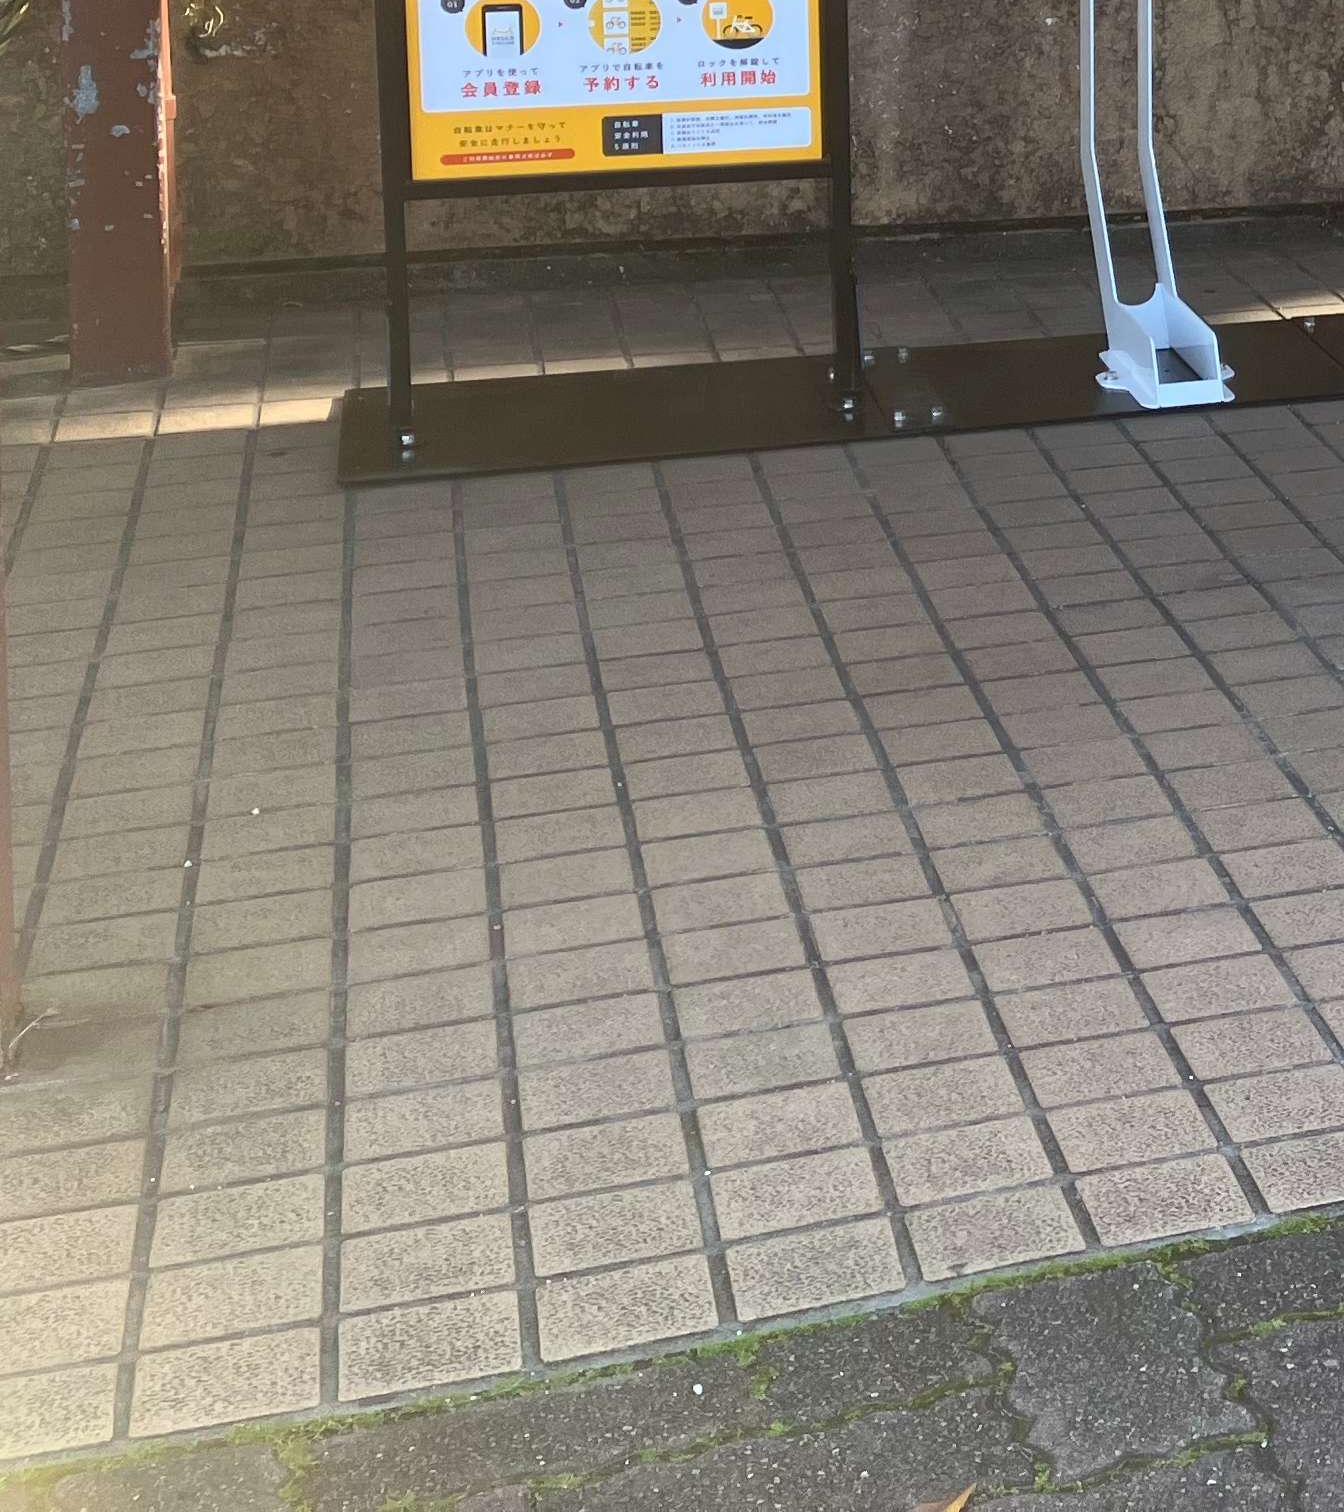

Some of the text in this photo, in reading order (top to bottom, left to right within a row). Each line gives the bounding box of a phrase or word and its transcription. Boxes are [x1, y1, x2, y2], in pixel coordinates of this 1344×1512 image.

[463, 67, 539, 78] アプリを使って
[579, 61, 664, 73] アプリで自転車を
[583, 74, 659, 93] 予約する
[700, 69, 777, 88] 利用開始
[461, 79, 541, 97] 会員登録
